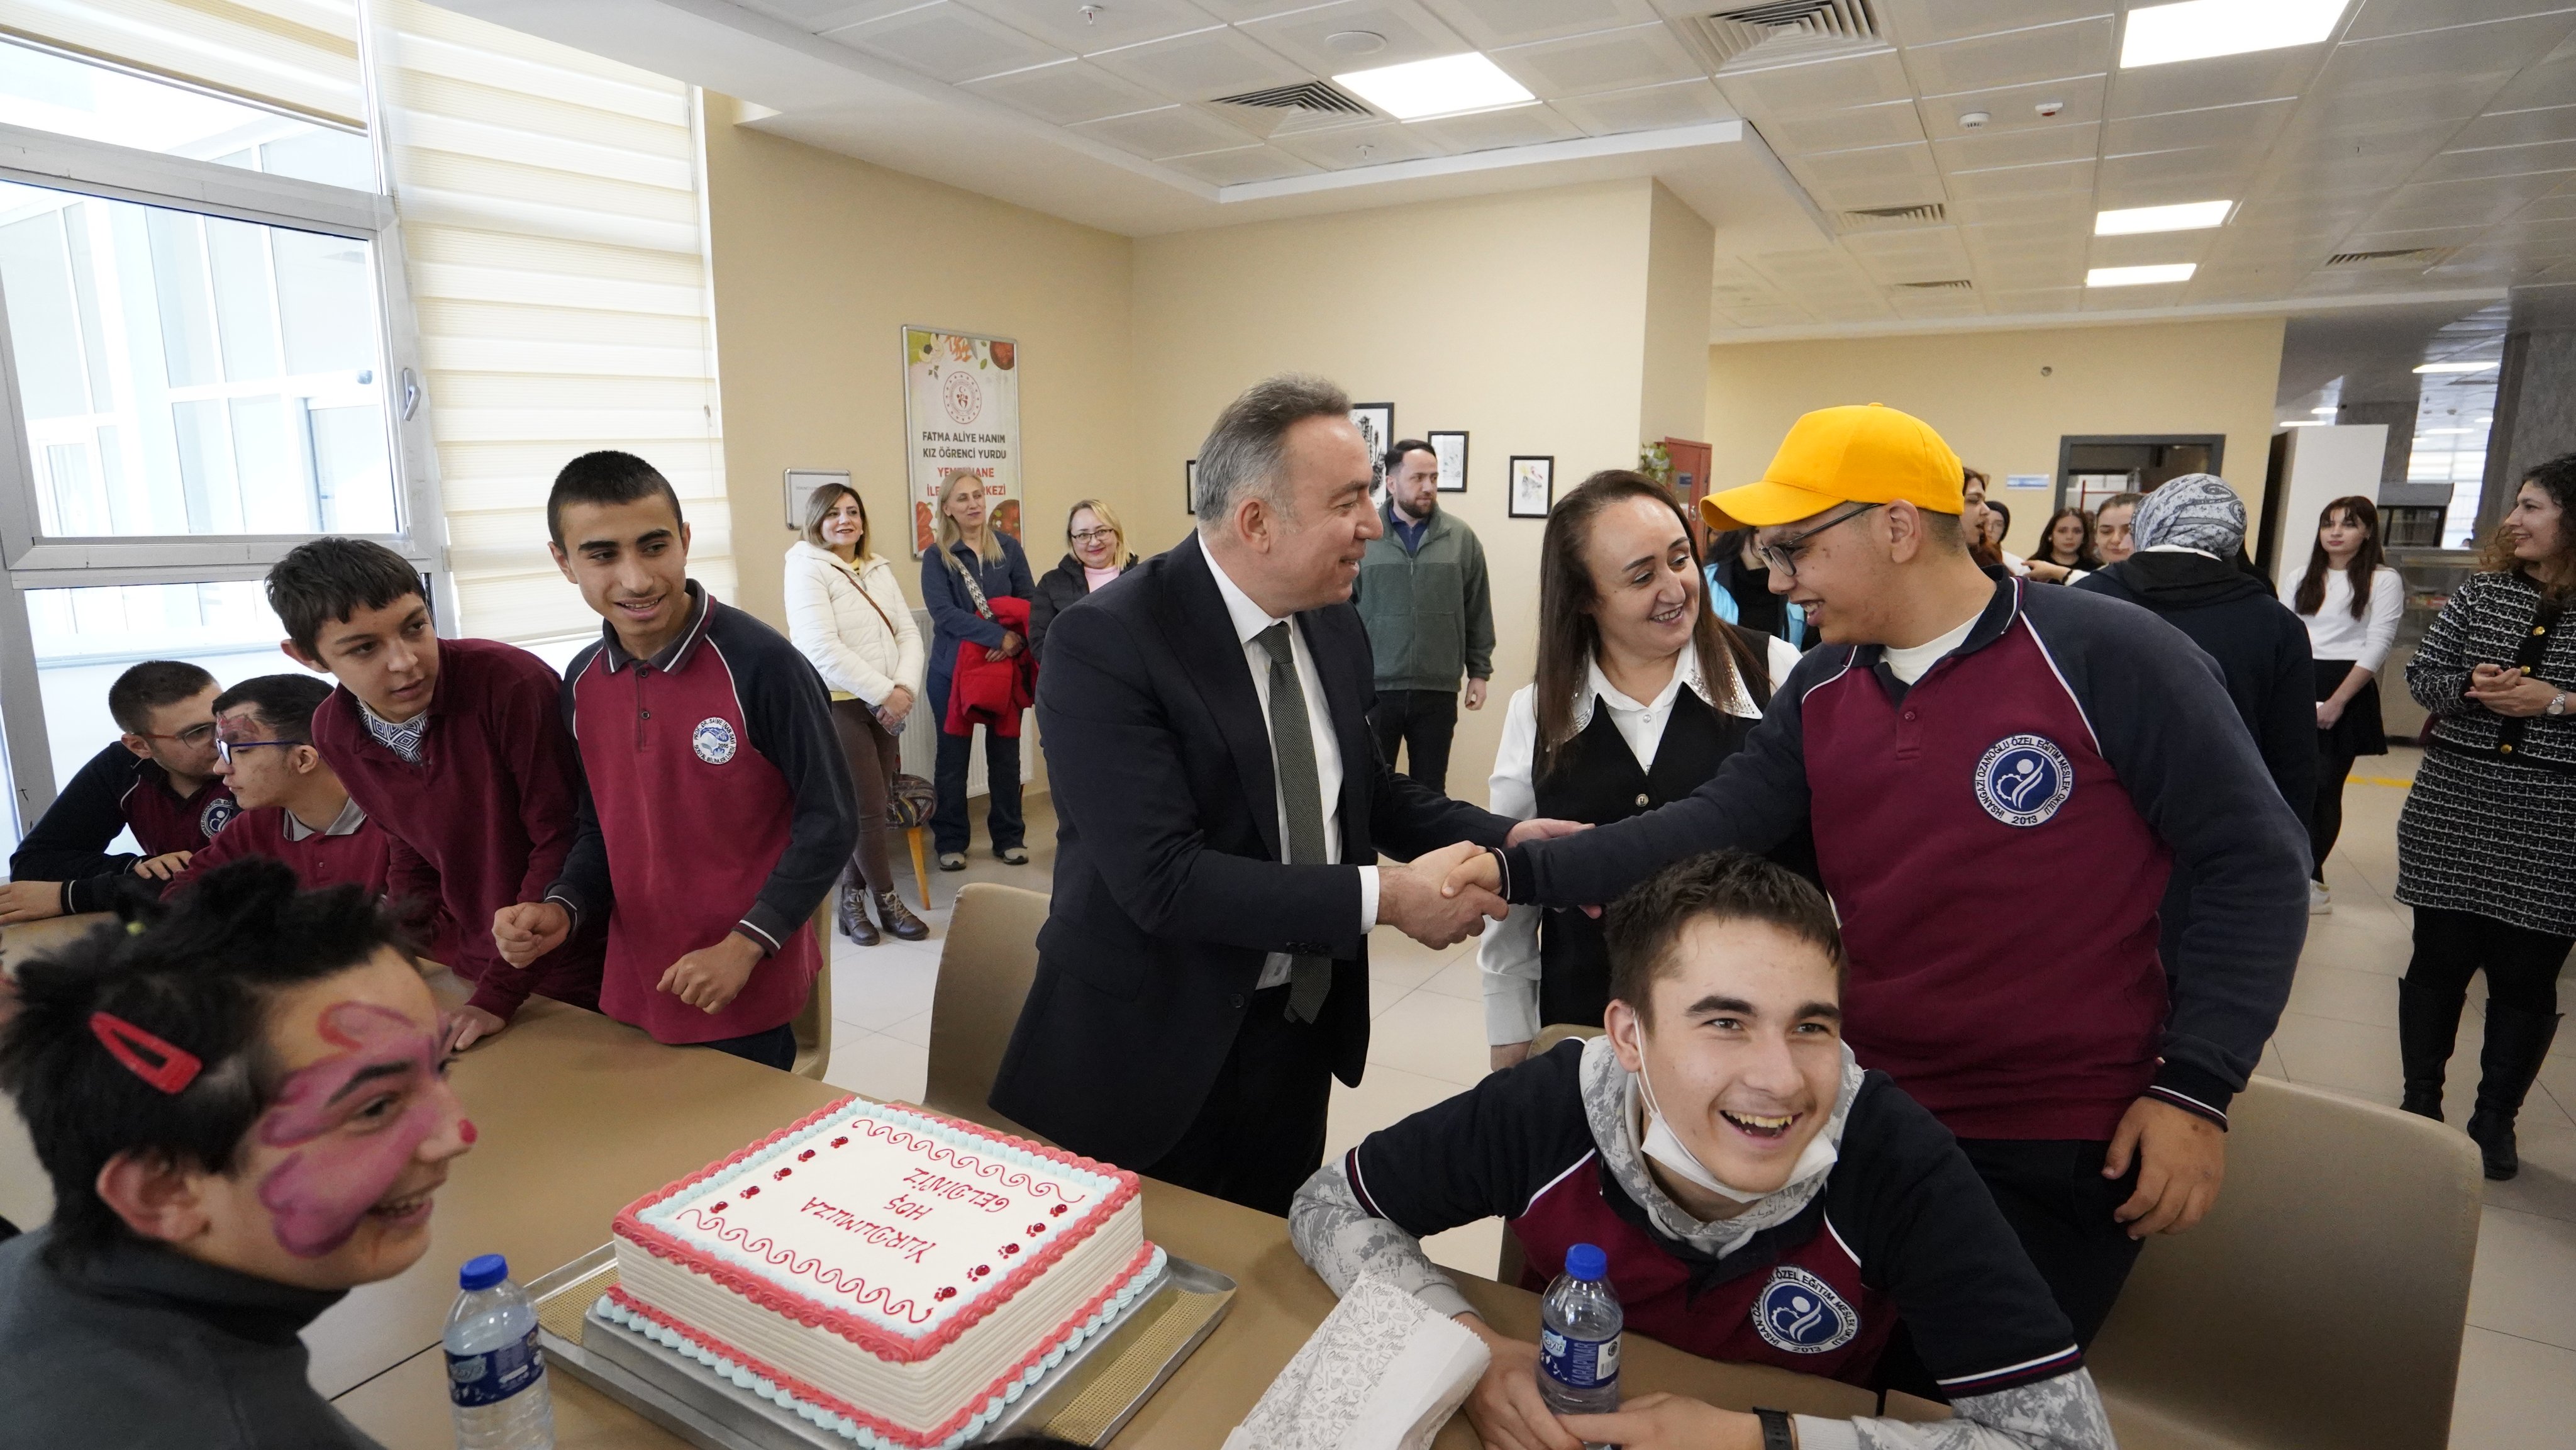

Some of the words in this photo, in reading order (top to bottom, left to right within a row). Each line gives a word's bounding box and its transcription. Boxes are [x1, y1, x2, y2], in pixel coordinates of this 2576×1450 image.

[923, 432, 950, 442] FATMA
[953, 431, 977, 442] ALİYE
[979, 433, 1005, 443] HANIM
[923, 448, 936, 458] KIZ
[939, 445, 975, 459] ÖĞRENCİ
[979, 449, 1006, 459] YURDU
[2011, 737, 2035, 746] ÖZEL
[2036, 739, 2061, 761] EĞİTİM
[1977, 740, 2010, 778] OZANOĞLU
[2058, 759, 2071, 792] MESLEK
[2044, 794, 2065, 816] OKULU
[2011, 815, 2038, 825] 2013
[902, 1167, 1009, 1213] GELDİNİZ
[883, 1195, 933, 1222] HOŞ
[800, 1196, 937, 1264] YURDUMUZA
[1775, 1268, 1799, 1281] ÖZEL
[1802, 1275, 1835, 1302] EĞİTİM
[1571, 1342, 1597, 1386] KARAPINAR
